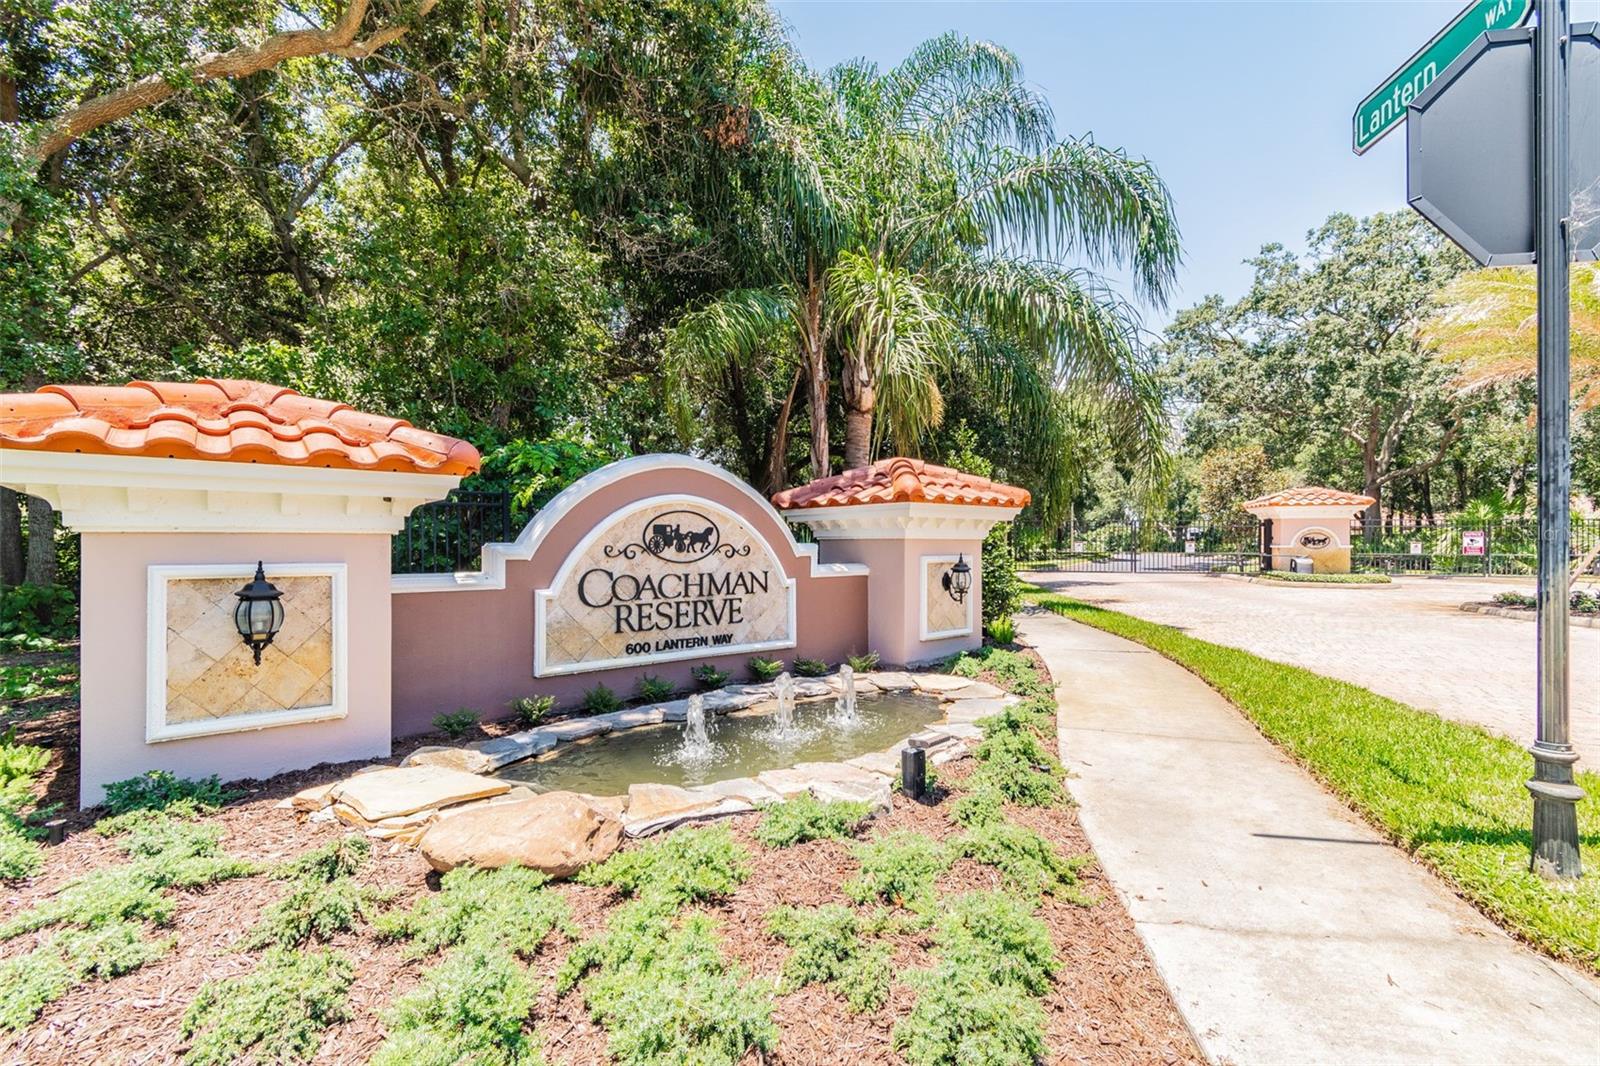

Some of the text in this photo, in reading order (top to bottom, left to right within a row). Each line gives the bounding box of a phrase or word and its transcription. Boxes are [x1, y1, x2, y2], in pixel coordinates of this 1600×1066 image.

[1360, 0, 1512, 143] Lantern WAY
[577, 568, 769, 608] COACHMAN
[614, 598, 744, 634] RESERVE
[625, 633, 734, 655] 600 LANTERN WAY
